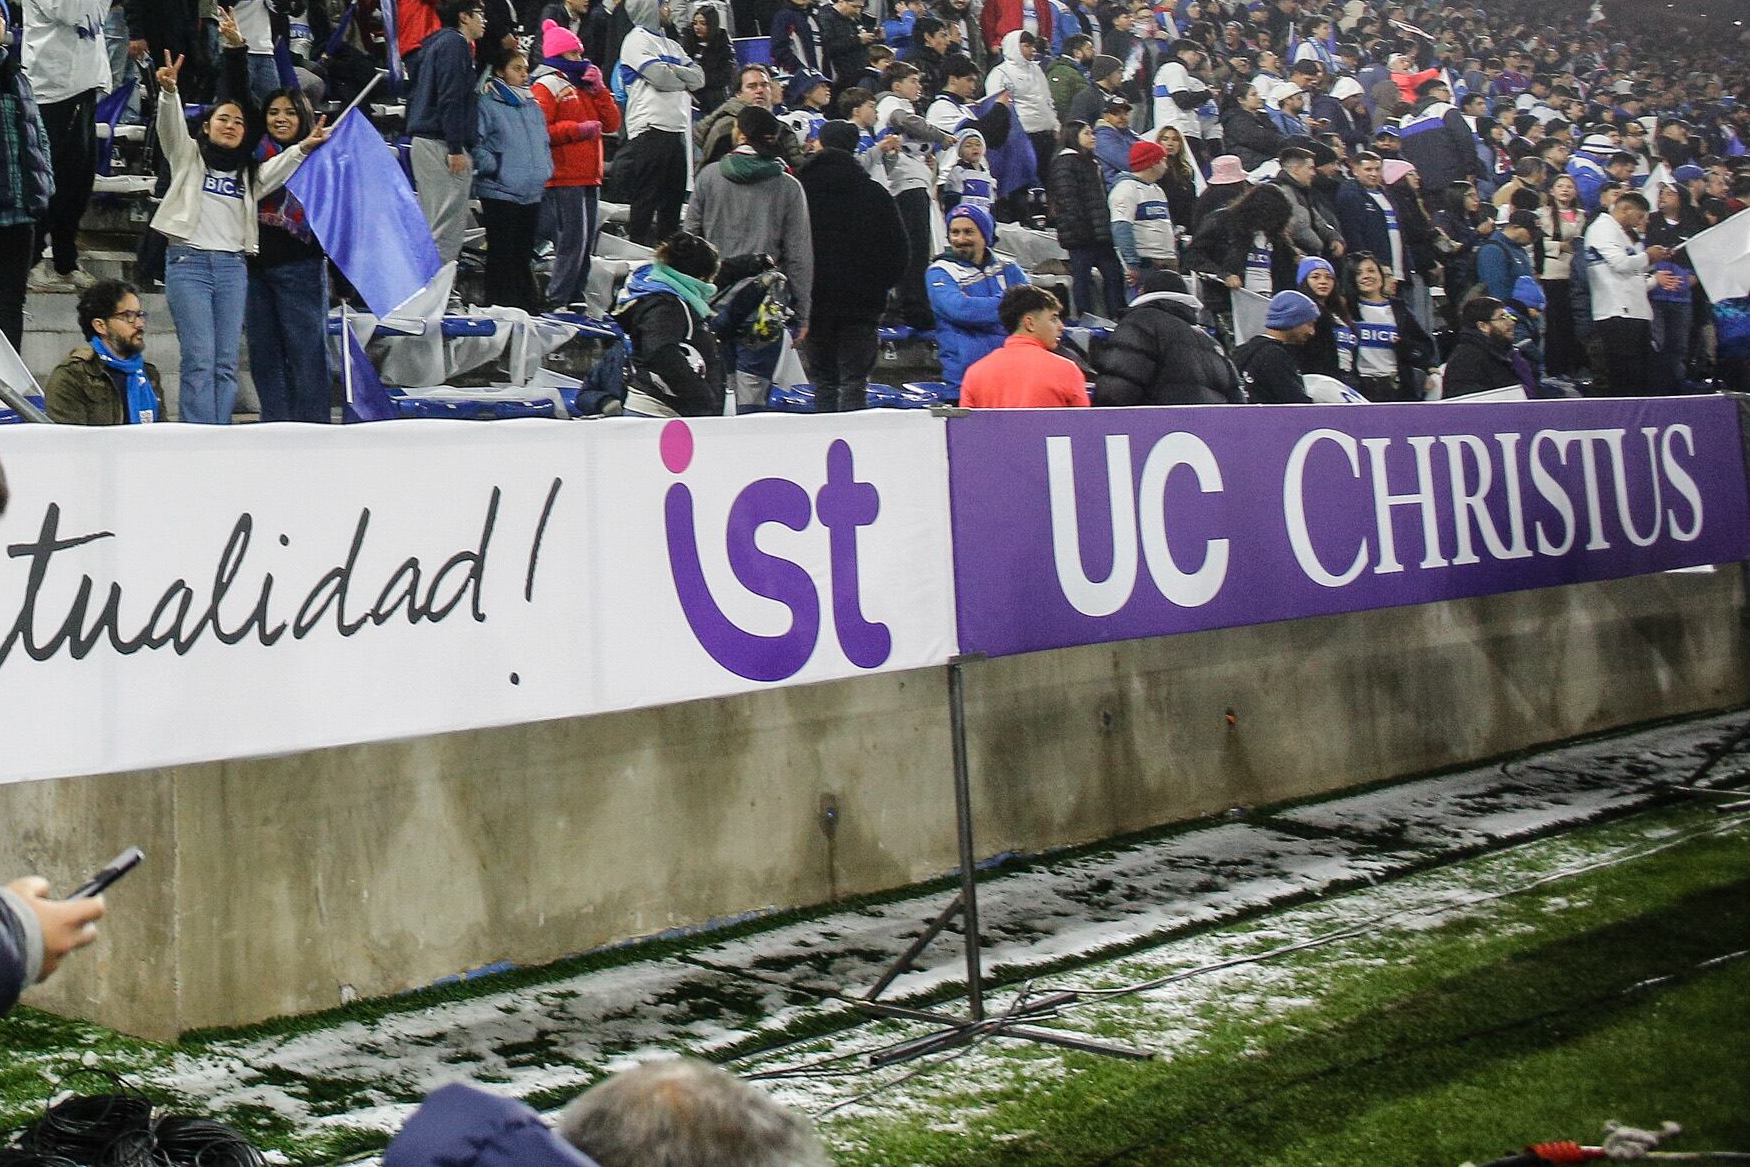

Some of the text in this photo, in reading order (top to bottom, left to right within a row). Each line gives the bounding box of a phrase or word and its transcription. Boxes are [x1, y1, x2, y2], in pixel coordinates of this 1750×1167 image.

[660, 419, 892, 682] ist
[1046, 422, 1704, 617] UC CHRISTUS
